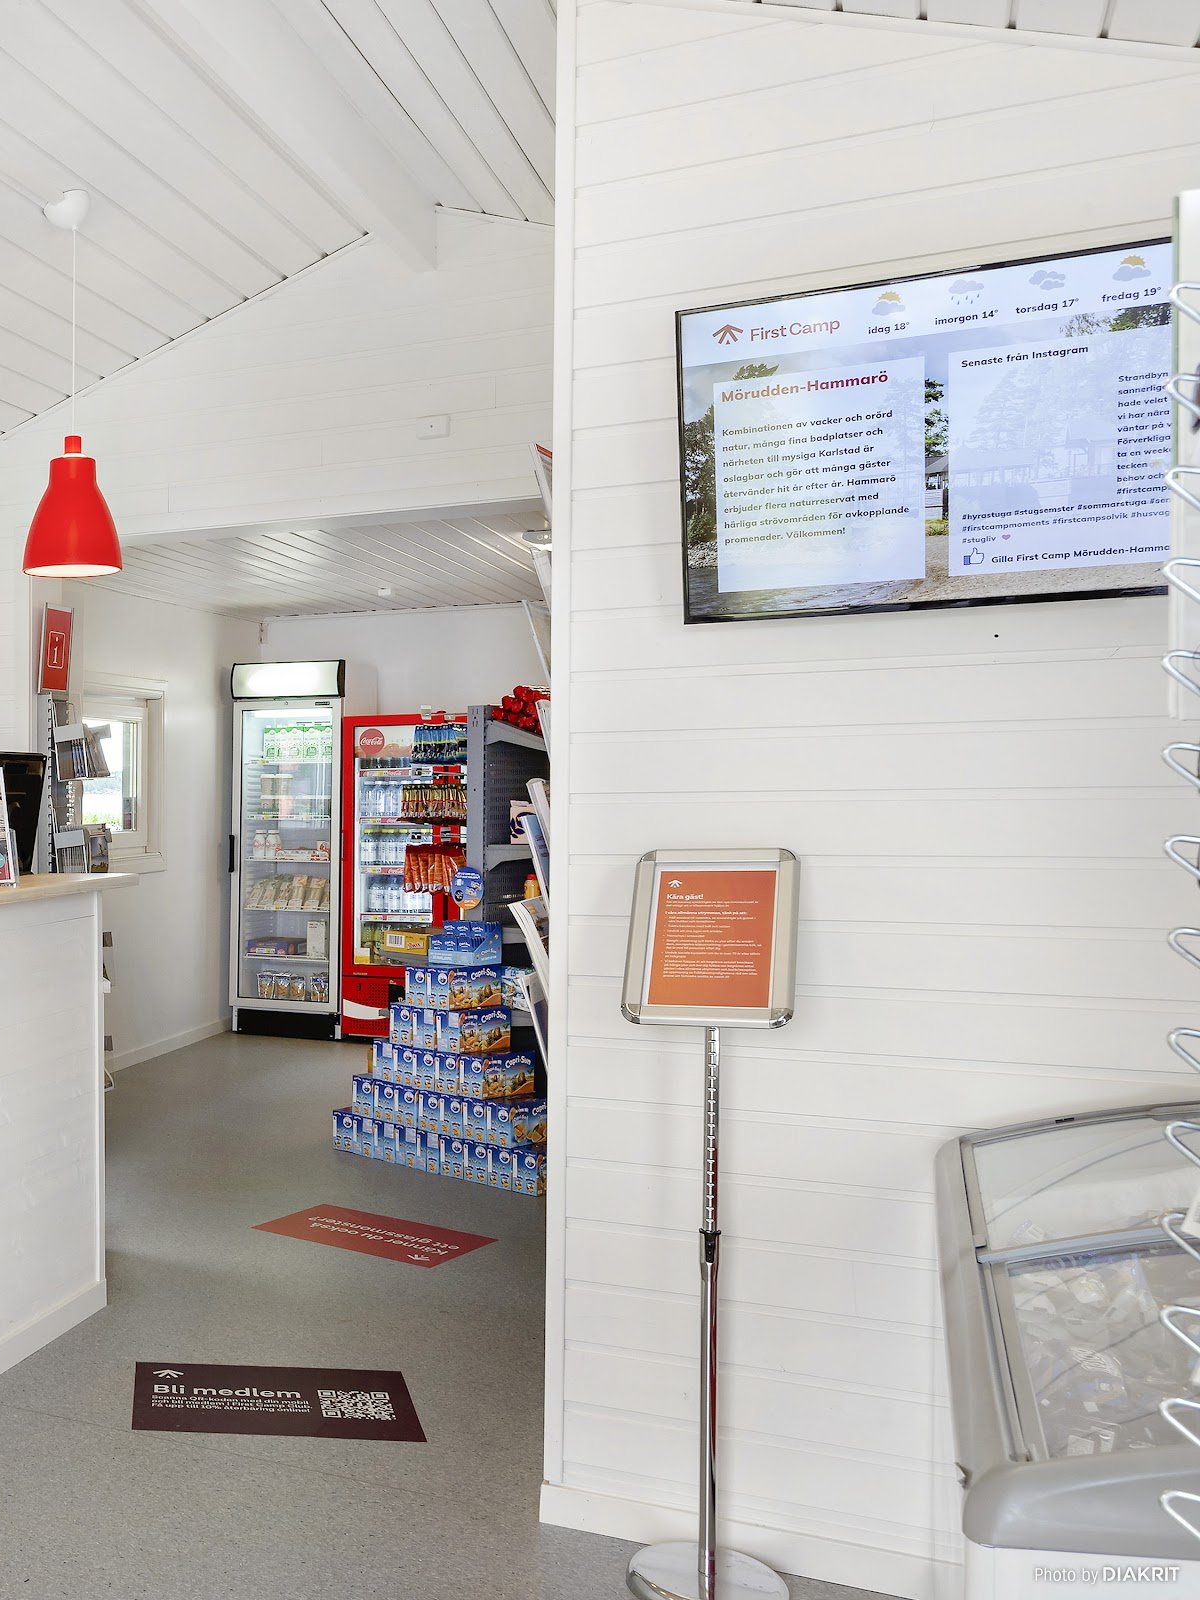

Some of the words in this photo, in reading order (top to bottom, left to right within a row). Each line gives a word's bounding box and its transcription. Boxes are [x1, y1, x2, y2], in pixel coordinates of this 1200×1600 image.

[1101, 289, 1140, 302] fredag
[1144, 286, 1162, 297] 19°
[1016, 300, 1058, 314] torsdag
[1062, 298, 1079, 308] 17°
[935, 313, 978, 325] imorgon
[982, 309, 999, 319] 14°
[750, 325, 787, 341] First
[789, 320, 840, 336] Camp
[868, 326, 891, 335] idag
[894, 321, 910, 331] 18°
[961, 357, 1003, 369] Senaste
[1006, 352, 1029, 363] från
[1032, 346, 1089, 359] Instagram
[1118, 371, 1169, 383] Strandbyn
[721, 370, 888, 402] Mörudden-Hammarö
[1117, 399, 1141, 408] hade
[1144, 396, 1168, 405] velat
[1117, 412, 1126, 420] vi
[1147, 409, 1170, 418] nära
[722, 422, 793, 437] Kombinationen
[796, 420, 808, 428] av
[810, 416, 843, 427] vacker
[845, 413, 863, 423] och
[865, 410, 893, 420] orörd
[1117, 424, 1149, 433] väntar
[1151, 421, 1164, 431] på
[722, 443, 750, 453] natur,
[753, 439, 786, 451] många
[788, 436, 807, 445] fina
[810, 430, 863, 444] badplatser
[866, 428, 883, 436] och
[1117, 434, 1171, 445] Förverkliga
[723, 456, 764, 467] närheten
[767, 454, 779, 463] till
[782, 451, 816, 463] mysiga
[819, 445, 860, 458] Karlstad
[863, 445, 874, 453] är
[723, 472, 765, 483] oslagbar
[767, 470, 784, 479] och
[786, 468, 802, 479] gör
[805, 466, 820, 475] att
[822, 463, 856, 475] många
[858, 459, 891, 471] gäster
[1117, 461, 1148, 470] tecken
[1117, 473, 1146, 483] behov
[723, 487, 775, 499] återvänder
[777, 484, 790, 493] hit
[792, 483, 803, 492] år
[805, 481, 828, 491] efter
[831, 479, 844, 489] år.
[847, 474, 896, 487] Hammarö
[1116, 485, 1170, 495] #firstcamp
[724, 502, 763, 514] erbjuder
[765, 501, 787, 510] flera
[789, 495, 855, 508] naturreservat
[858, 492, 879, 501] med
[962, 510, 1012, 520] #hyrastuga
[1014, 504, 1074, 516] #stugsemster
[1077, 498, 1147, 510] #sommarstuga
[724, 518, 757, 529] härliga
[759, 512, 826, 526] strövområden
[828, 510, 843, 519] för
[845, 506, 910, 518] avkopplande
[962, 518, 1050, 531] #firstcampmoments
[1052, 512, 1128, 525] #firstcampsolvik
[1131, 510, 1170, 518] #husvag
[724, 533, 784, 546] promenader.
[786, 527, 846, 539] Välkommen!
[962, 535, 996, 545] #stugliv
[991, 554, 1014, 564] Gilla
[1017, 553, 1039, 562] First
[1041, 551, 1070, 561] Camp
[1073, 544, 1170, 557] Mörudden-Hamma
[685, 893, 704, 901] gäst!
[470, 967, 497, 980] Capri-Sun
[481, 1010, 507, 1023] Capri-Sun
[505, 1055, 532, 1068] Capri-Sun
[532, 1101, 546, 1116] Capri
[309, 1222, 359, 1235] också
[361, 1233, 381, 1241] du
[385, 1238, 449, 1255] Känner
[432, 1240, 459, 1250] ett
[153, 1384, 185, 1394] Bli
[193, 1387, 301, 1398] medlem
